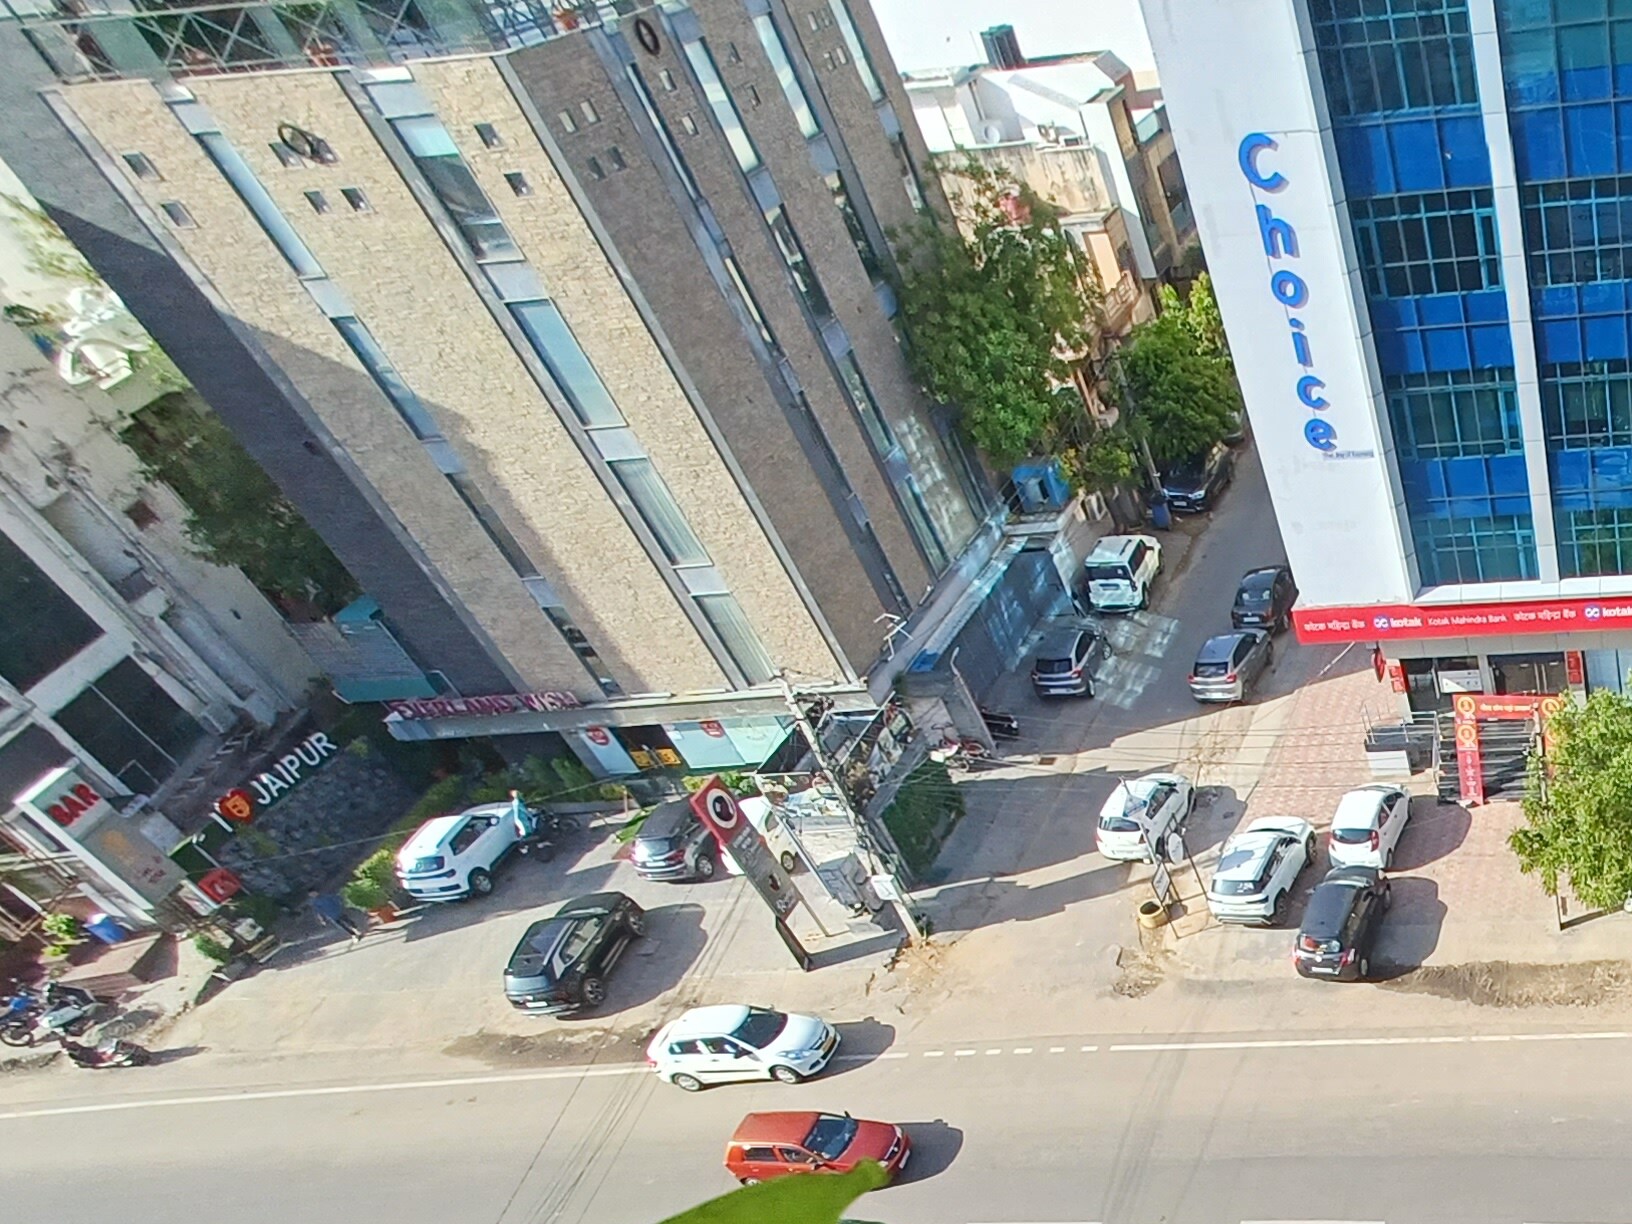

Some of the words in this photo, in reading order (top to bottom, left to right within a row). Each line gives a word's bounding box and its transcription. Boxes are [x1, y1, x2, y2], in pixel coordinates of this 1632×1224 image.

[1238, 132, 1337, 451] Choice
[1390, 618, 1422, 627] kotak
[1428, 617, 1450, 626] Kotak
[1451, 615, 1487, 625] Mahindra
[1488, 614, 1508, 623] Bank
[250, 731, 338, 805] JAIPUR
[48, 783, 100, 827] BAR
